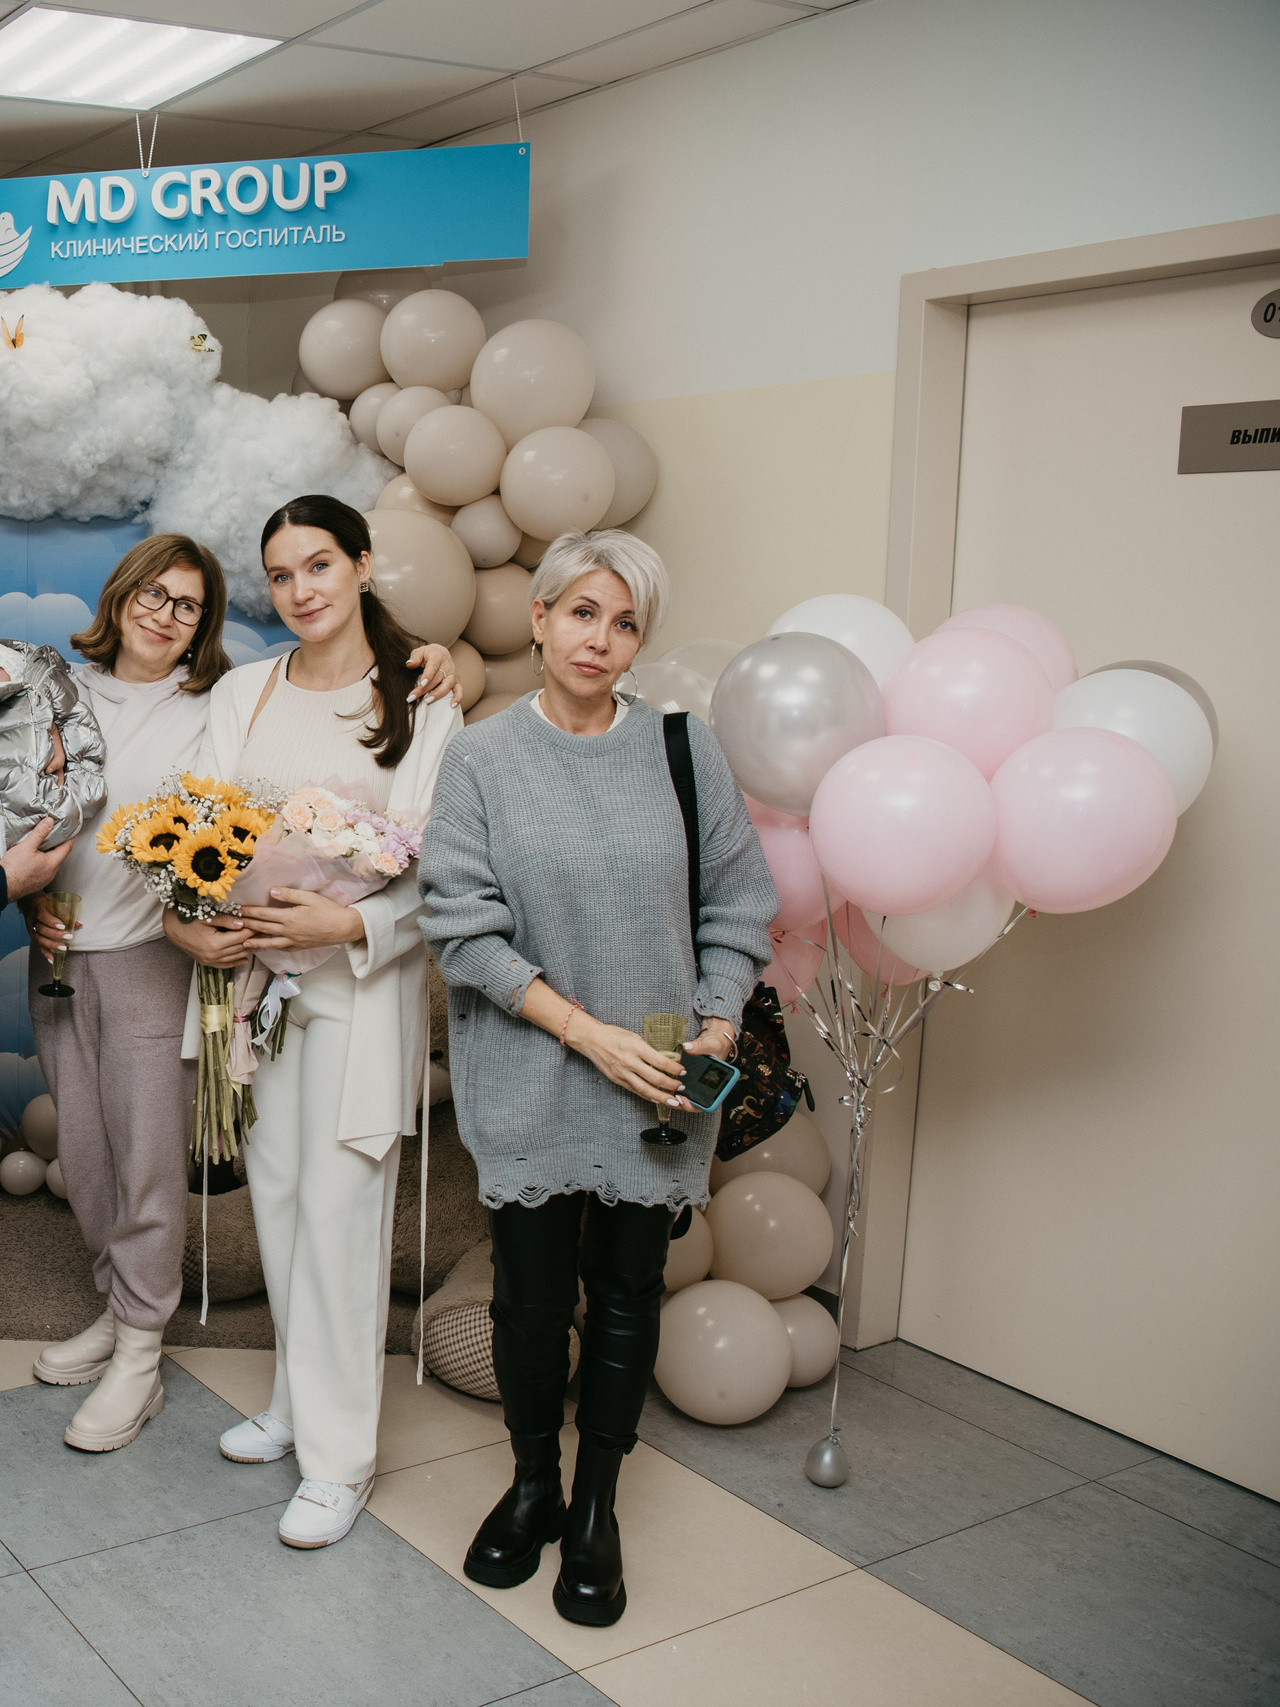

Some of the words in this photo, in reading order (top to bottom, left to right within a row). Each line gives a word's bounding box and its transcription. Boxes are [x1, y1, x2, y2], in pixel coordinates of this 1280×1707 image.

[46, 175, 137, 226] MD
[151, 160, 348, 220] GROUP
[50, 229, 208, 259] КЛИНИЧЕСКИЙ
[215, 224, 347, 249] ГОСПИТАЛЬ
[1263, 302, 1280, 323] 0
